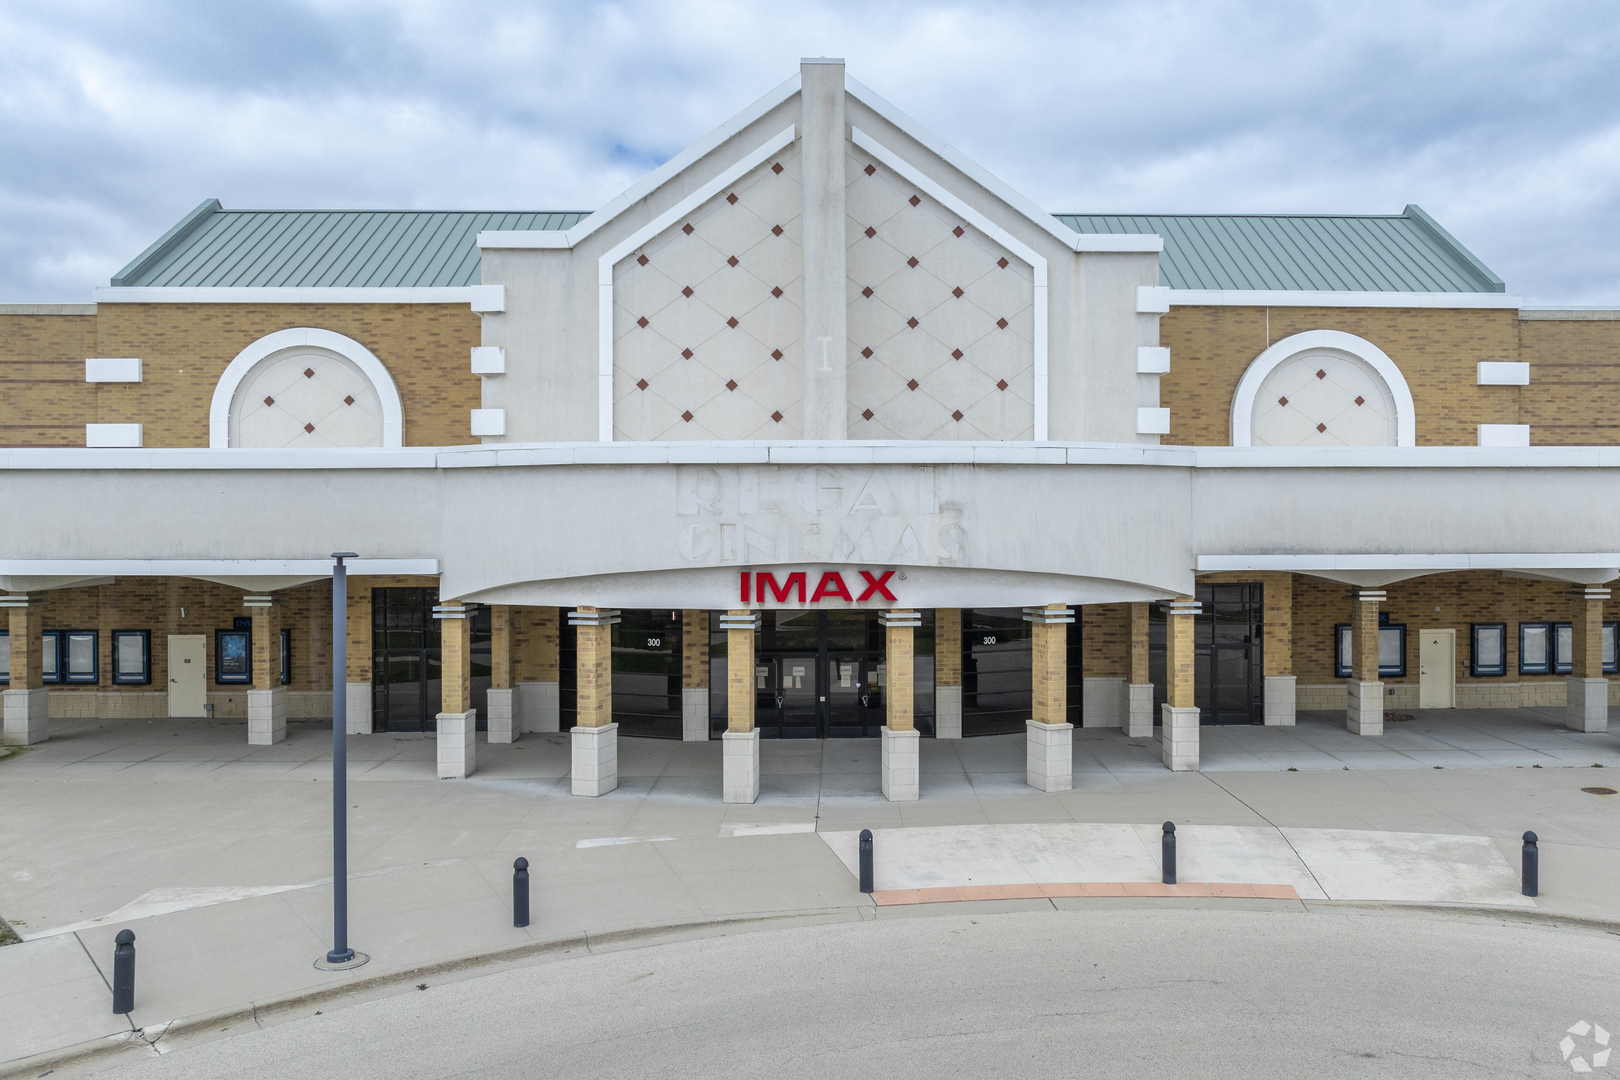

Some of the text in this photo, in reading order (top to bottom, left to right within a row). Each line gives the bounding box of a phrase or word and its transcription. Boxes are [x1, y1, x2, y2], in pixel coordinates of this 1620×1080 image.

[676, 464, 964, 516] REGAL
[677, 522, 968, 564] CINEMAS
[740, 570, 898, 603] IMAX
[236, 619, 252, 627] IM
[647, 638, 660, 647] 300
[983, 636, 996, 645] 300
